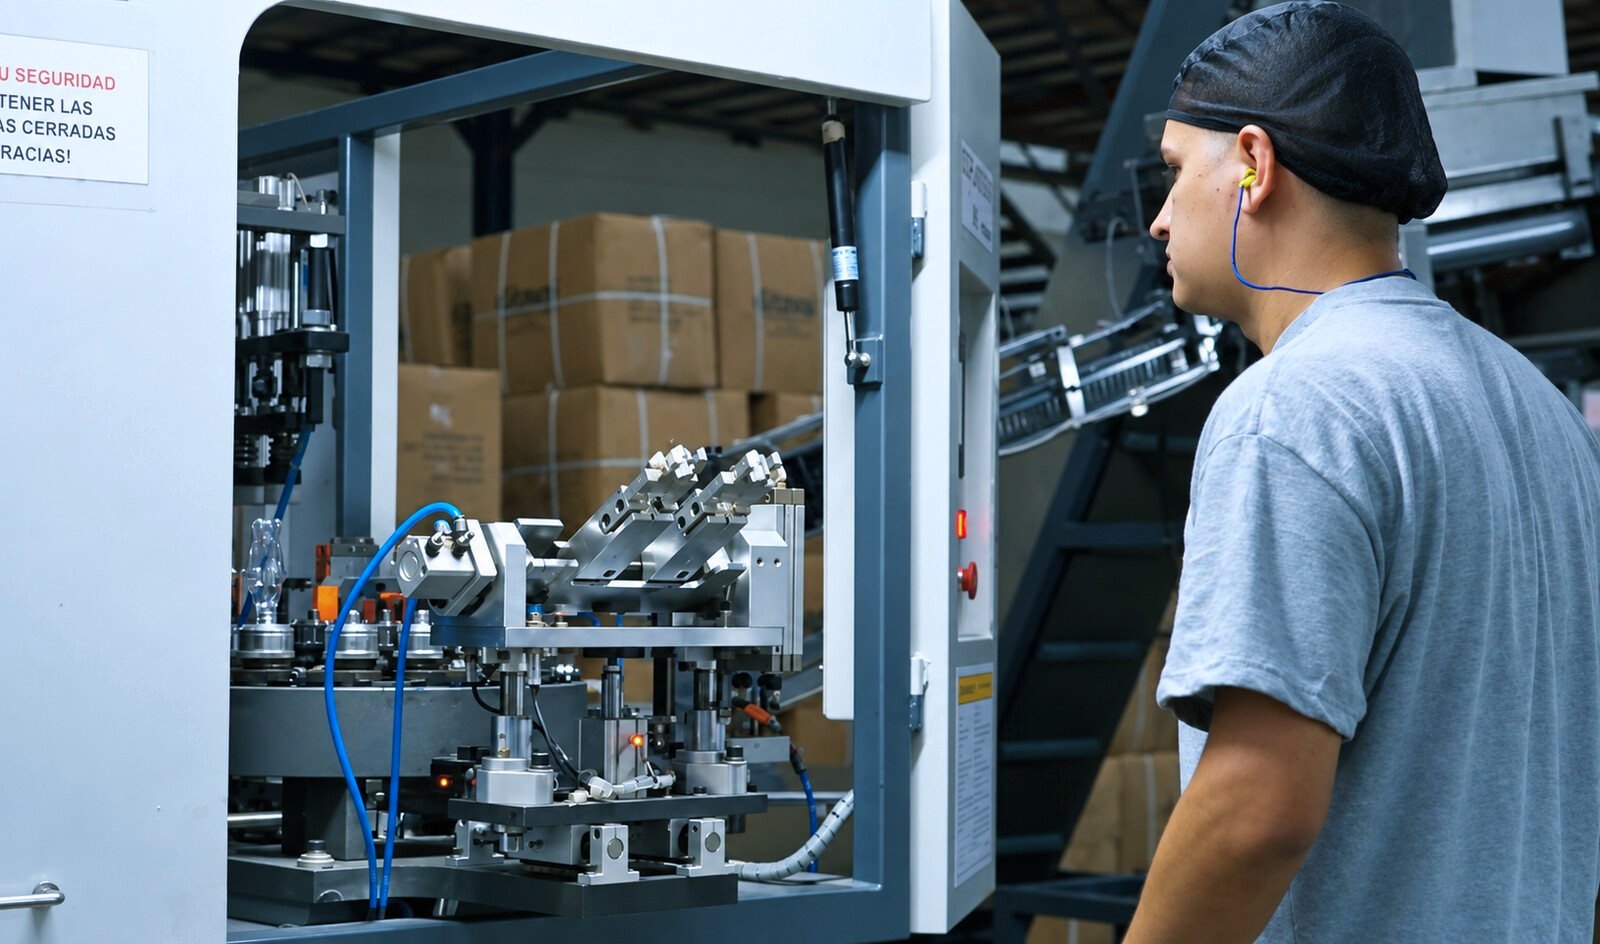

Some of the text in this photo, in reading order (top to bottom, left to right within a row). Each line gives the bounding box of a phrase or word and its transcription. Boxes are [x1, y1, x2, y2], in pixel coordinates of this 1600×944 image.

[15, 68, 115, 90] SEGURIDAD
[0, 94, 92, 115] TENER LAS
[22, 120, 115, 140] CERRADAS
[1, 145, 70, 163] RACIAS!
